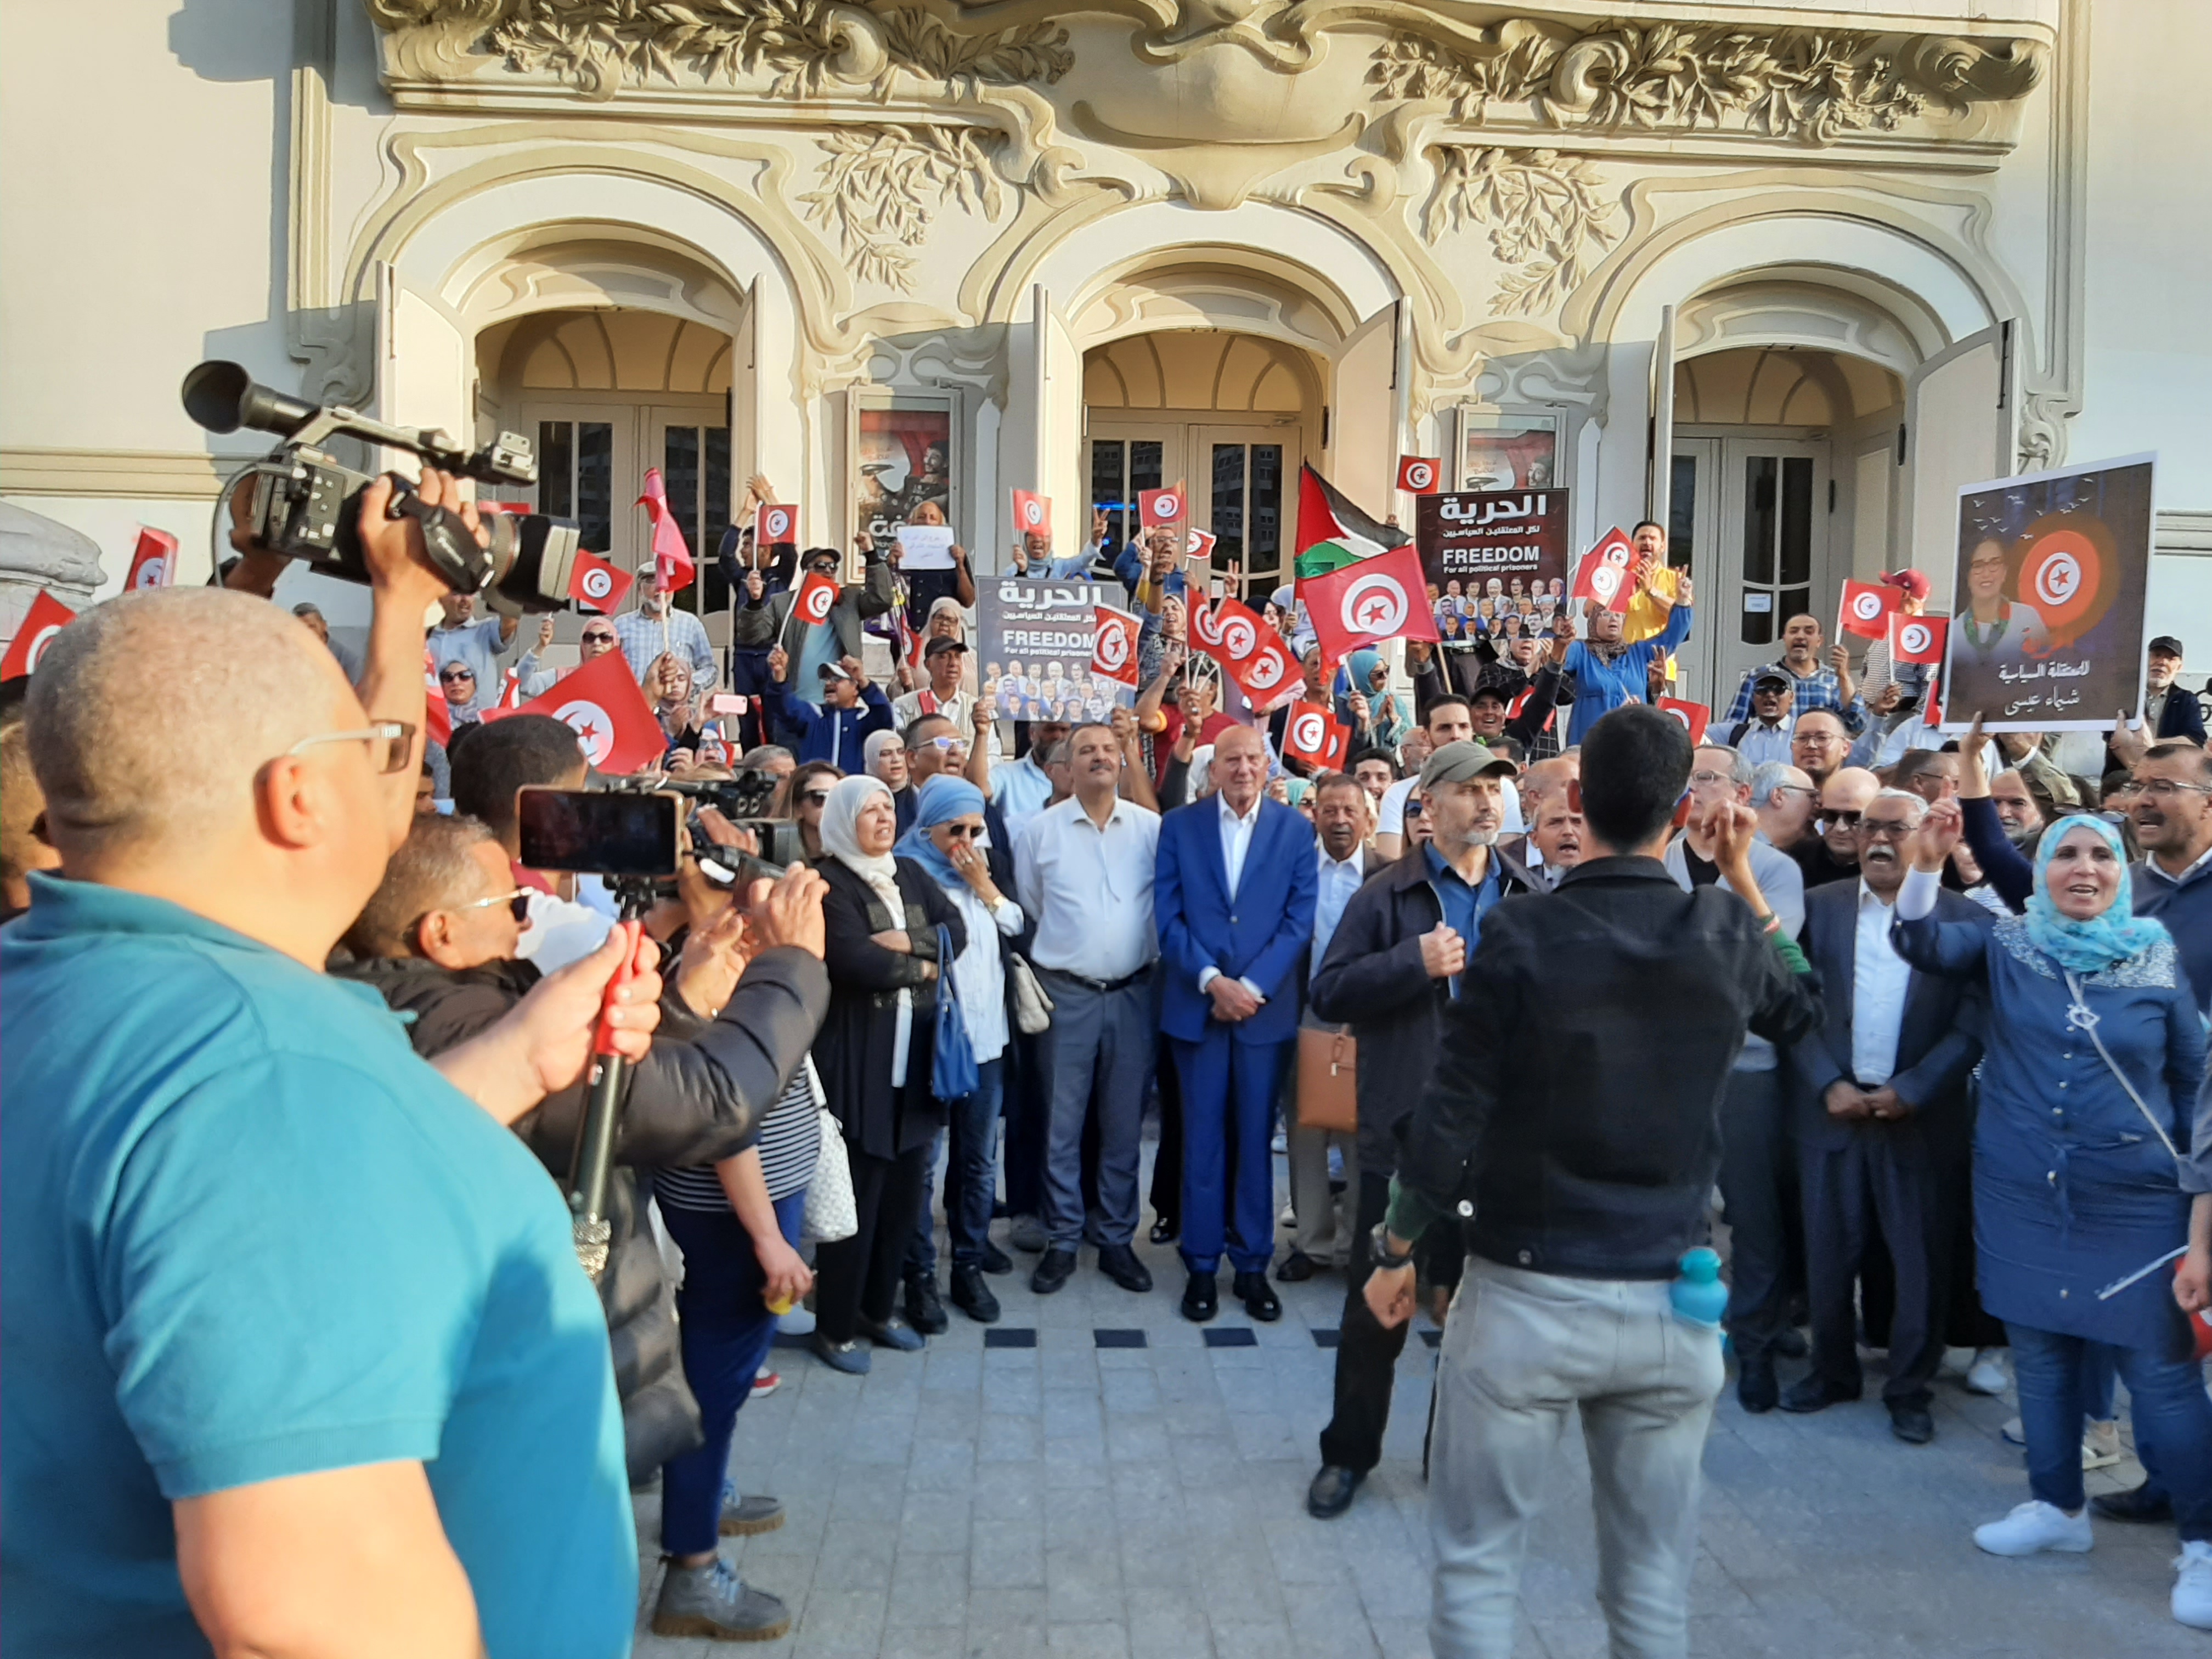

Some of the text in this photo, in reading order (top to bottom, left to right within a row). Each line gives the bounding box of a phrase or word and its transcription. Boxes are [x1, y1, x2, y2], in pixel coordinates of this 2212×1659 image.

[1440, 494, 1546, 524] الحرية
[1443, 525, 1541, 538] لكل المعتقلين السياسيين
[1442, 546, 1539, 565] FREEDOM
[1469, 565, 1500, 573] political
[1501, 564, 1538, 572] prisoners
[998, 581, 1102, 610] الحرية
[1030, 648, 1060, 656] political
[1998, 659, 2091, 685] المعتقلة السياسية
[2004, 685, 2081, 716] شيماء عيسى
